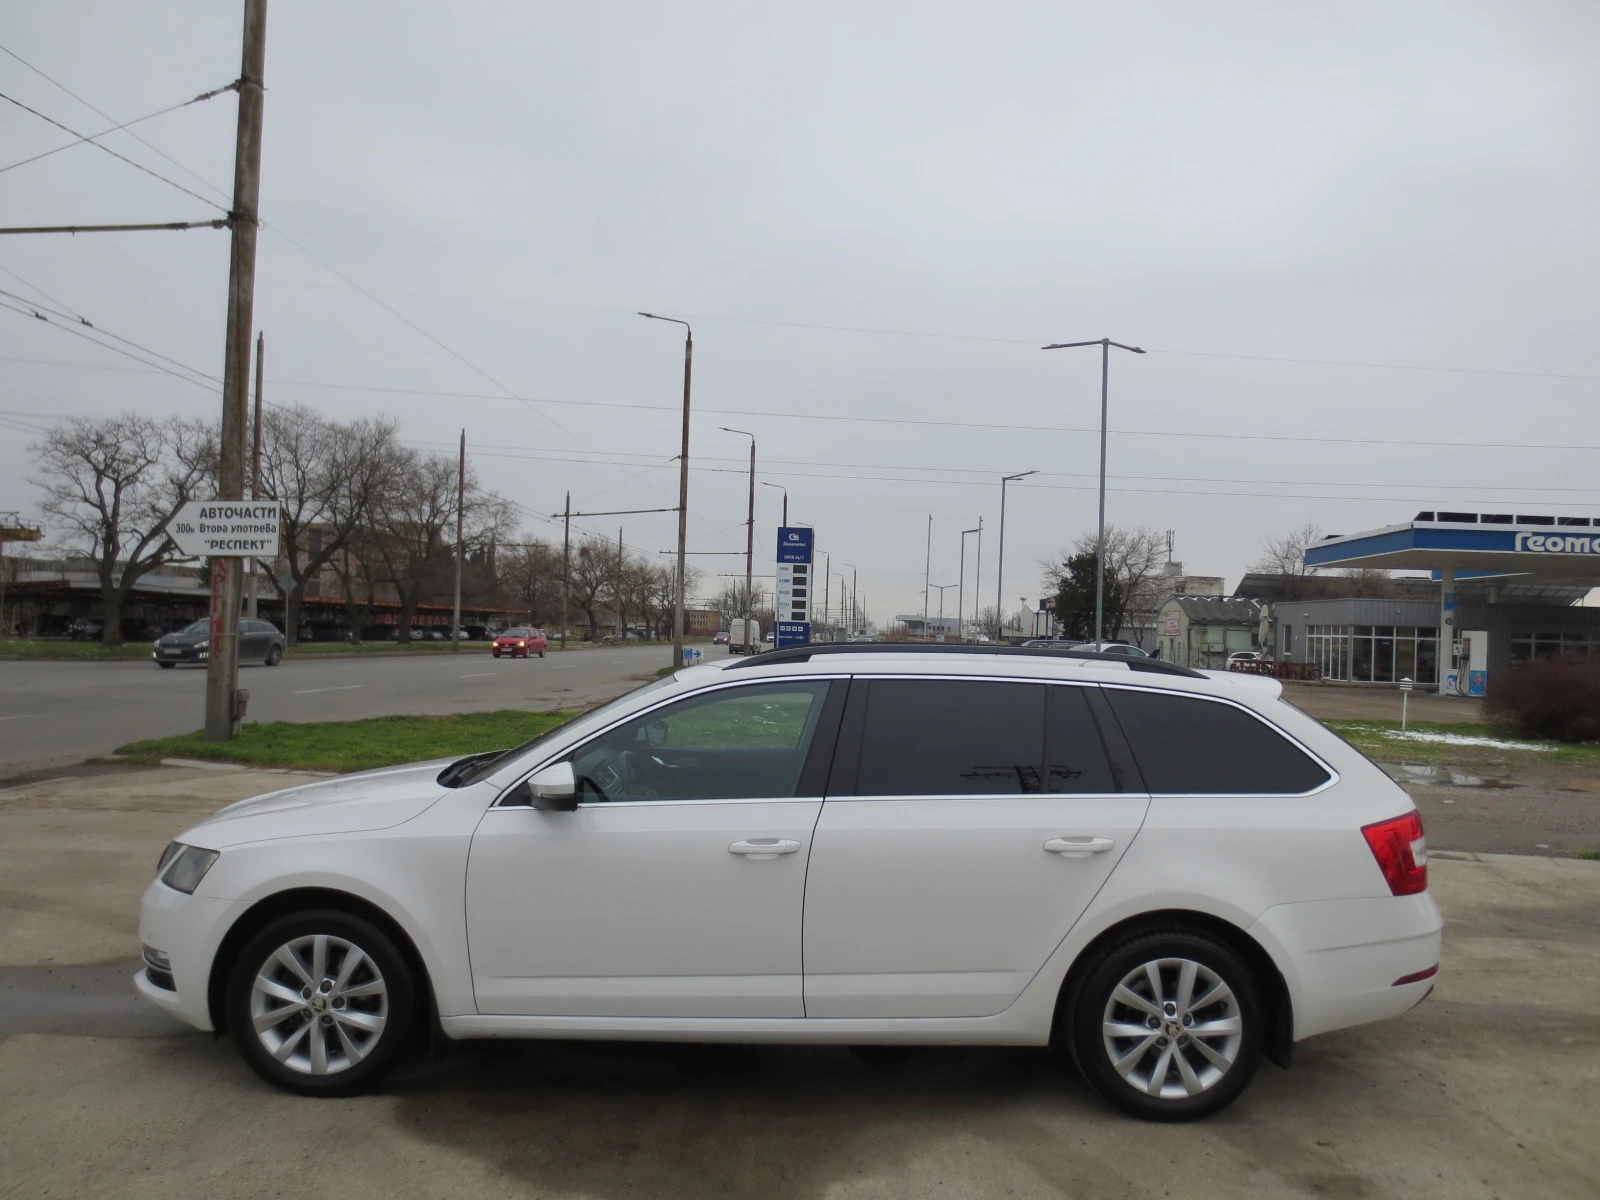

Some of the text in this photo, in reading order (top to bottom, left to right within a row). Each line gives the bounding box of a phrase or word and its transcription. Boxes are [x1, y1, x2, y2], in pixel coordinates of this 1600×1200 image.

[199, 507, 277, 519] АВТОЧАСТИ
[199, 523, 228, 534] Втора
[230, 523, 277, 534] употреба
[204, 539, 272, 550] "РЕСПЕКТ"
